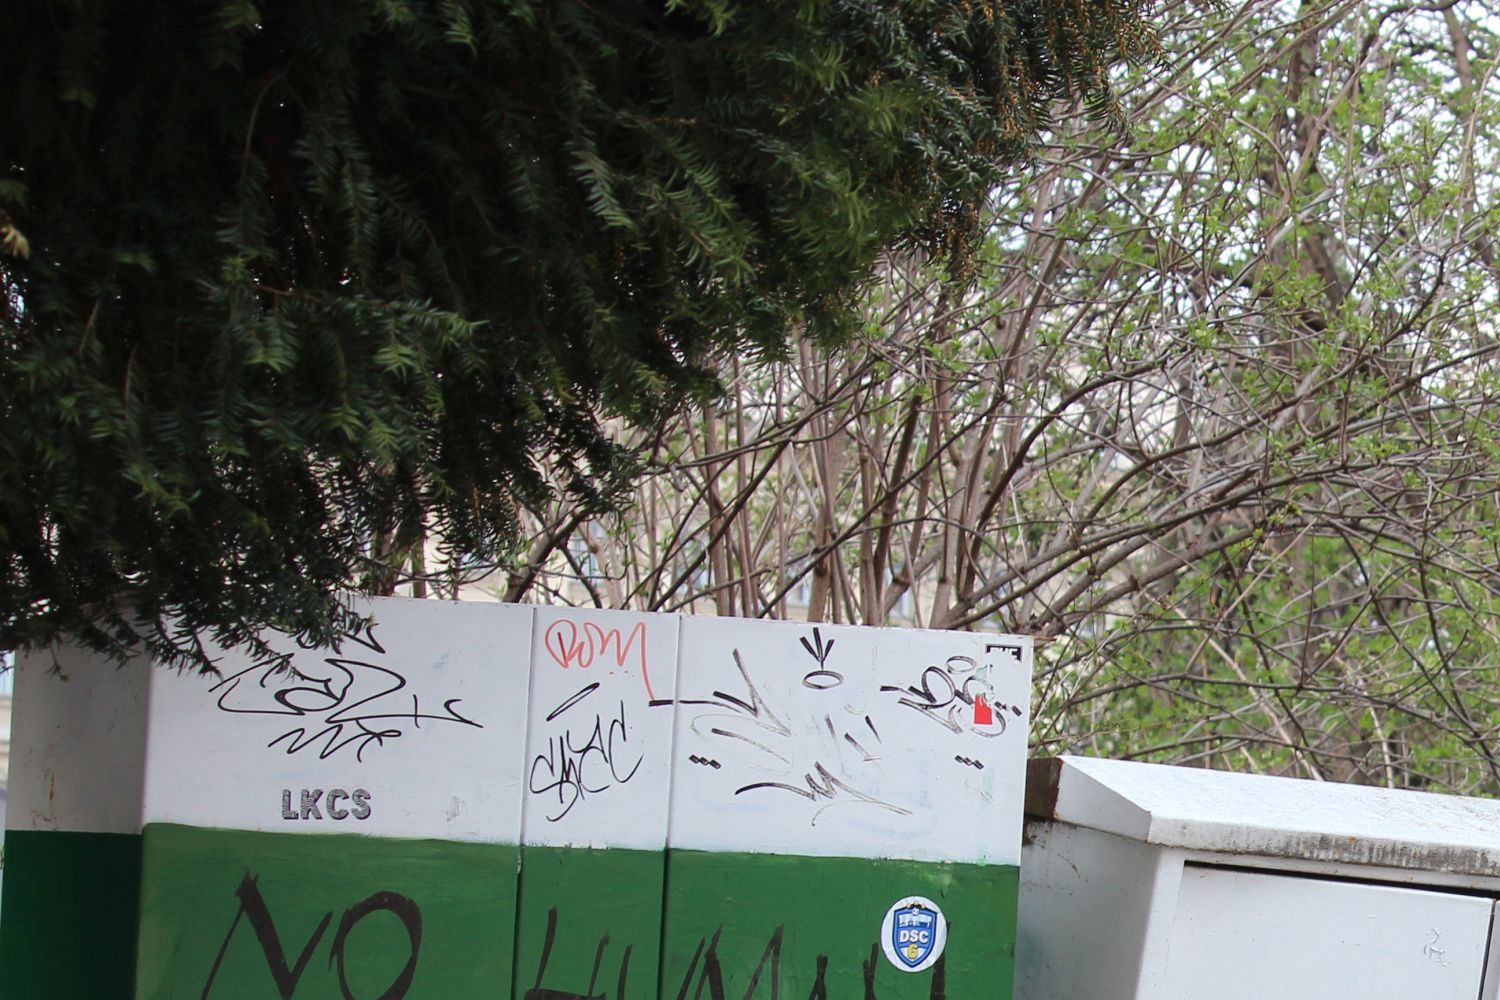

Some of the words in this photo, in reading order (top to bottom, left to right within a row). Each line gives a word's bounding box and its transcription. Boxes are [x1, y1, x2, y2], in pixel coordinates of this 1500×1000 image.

[282, 788, 372, 820] LKCS
[899, 929, 929, 944] DSC
[907, 943, 918, 959] 6
